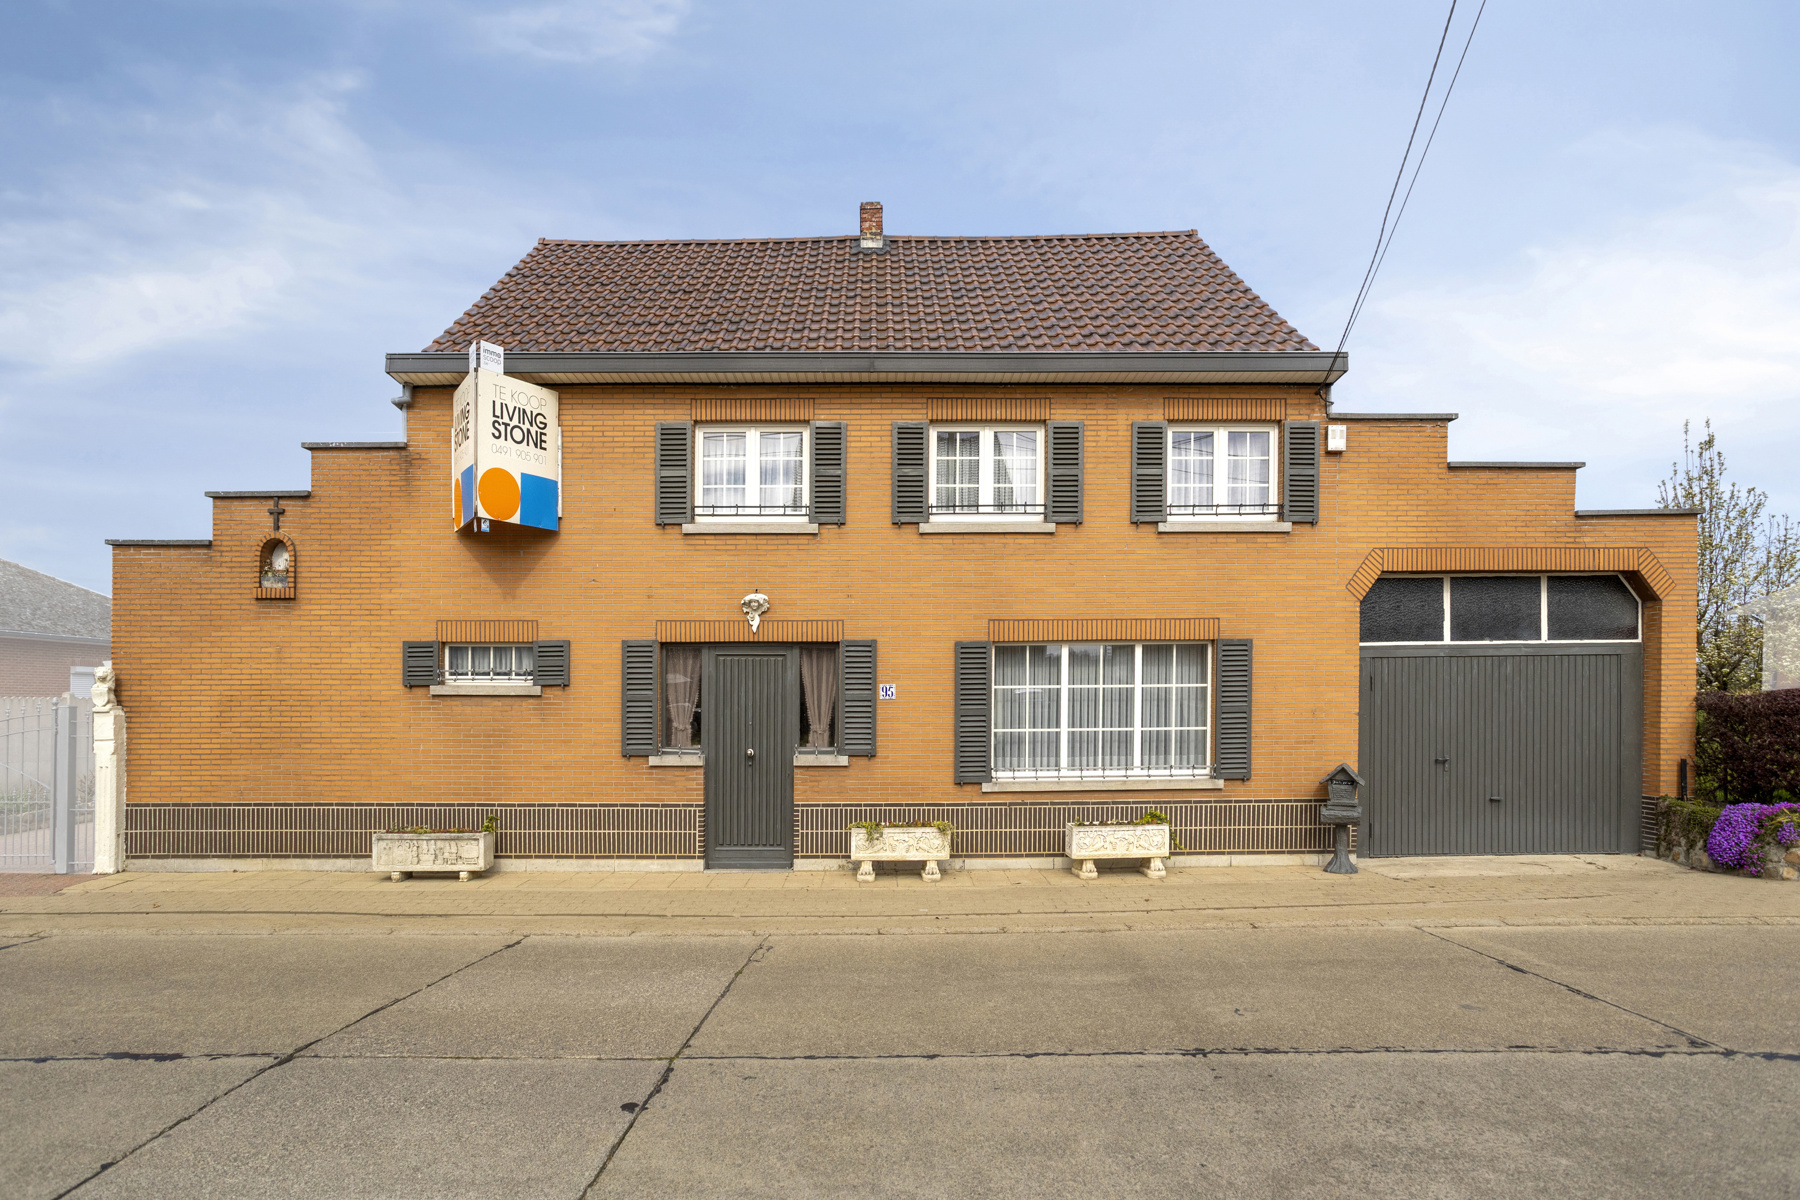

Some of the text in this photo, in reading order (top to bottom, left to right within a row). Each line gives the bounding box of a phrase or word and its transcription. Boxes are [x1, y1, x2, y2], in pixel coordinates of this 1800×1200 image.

[483, 346, 502, 359] immo
[483, 354, 502, 366] scoop
[493, 383, 506, 401] TE
[511, 389, 547, 411] KOOP
[492, 400, 548, 430] LIVING
[491, 419, 548, 452] STONE
[491, 443, 547, 466] 0491 905 901
[881, 685, 894, 698] 95
